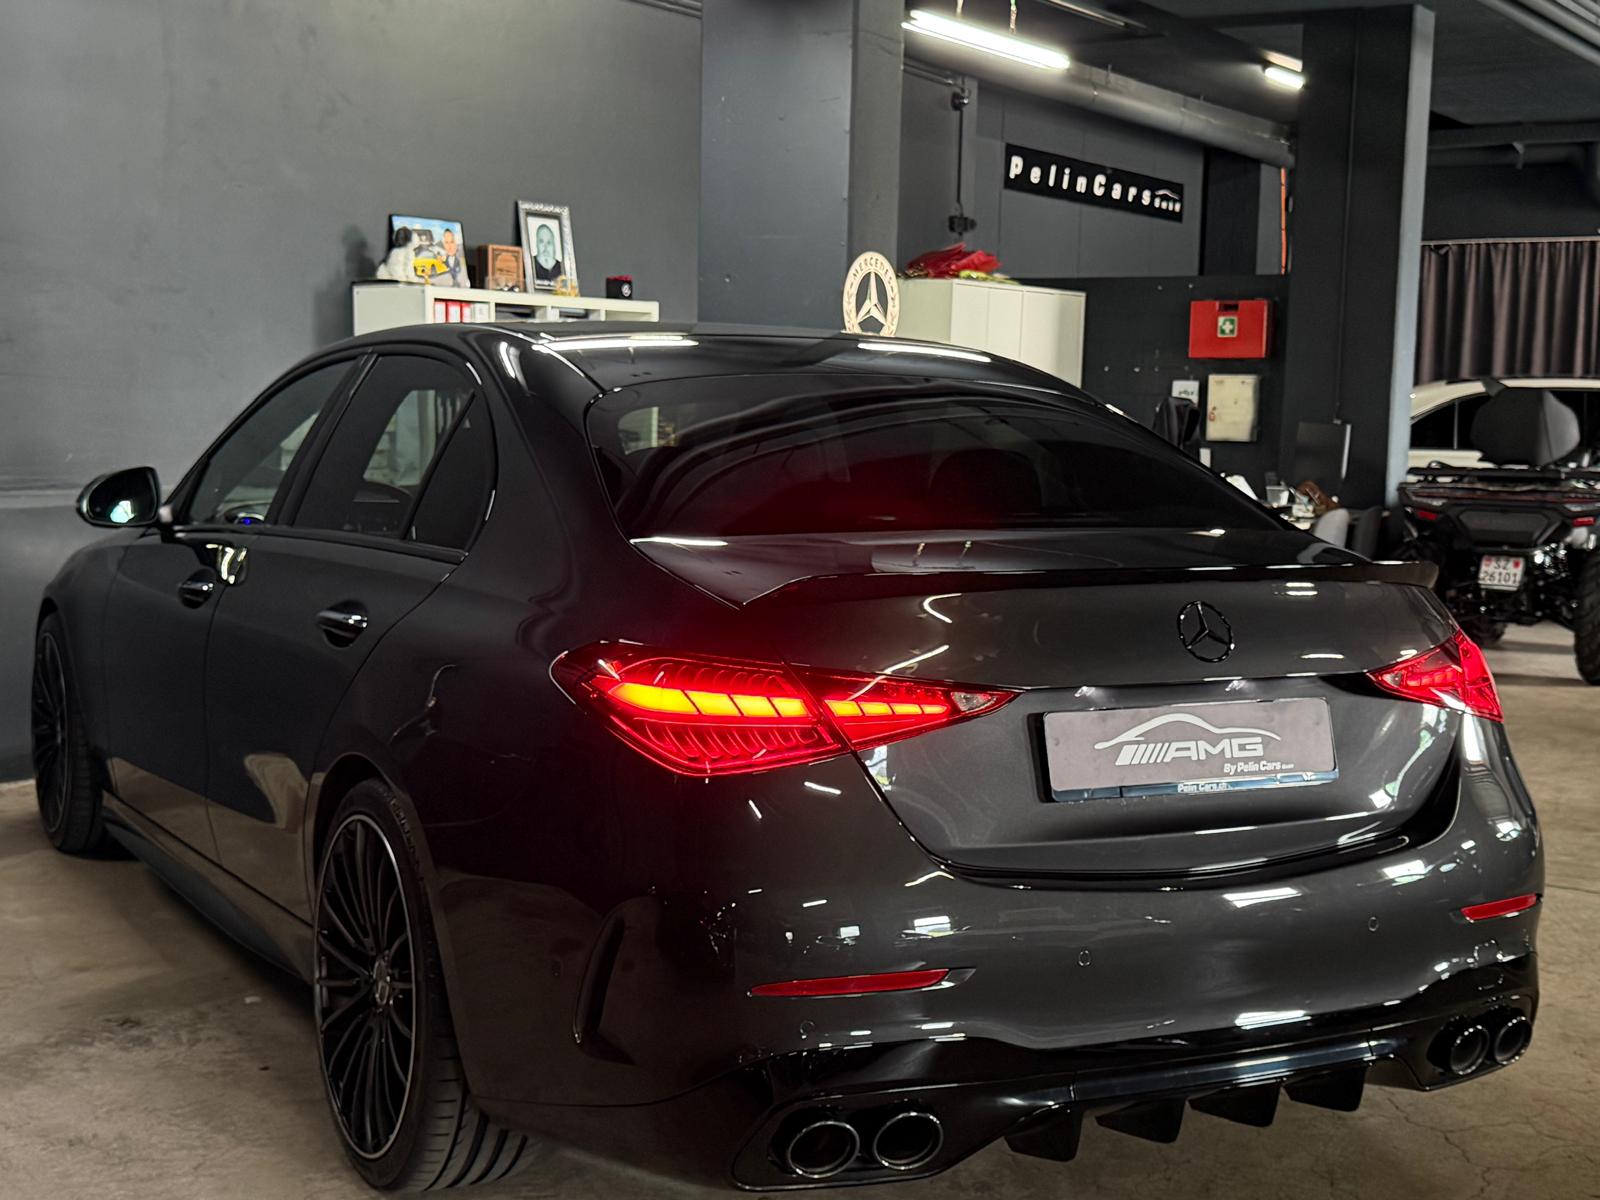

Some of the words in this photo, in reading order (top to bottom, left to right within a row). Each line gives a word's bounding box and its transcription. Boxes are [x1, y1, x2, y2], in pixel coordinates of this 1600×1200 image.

[1494, 556, 1511, 570] SZ
[1479, 569, 1518, 584] 26101
[1165, 737, 1264, 762] AMG
[1224, 763, 1236, 775] By
[1237, 762, 1259, 773] Pelin
[1260, 761, 1281, 772] Cars
